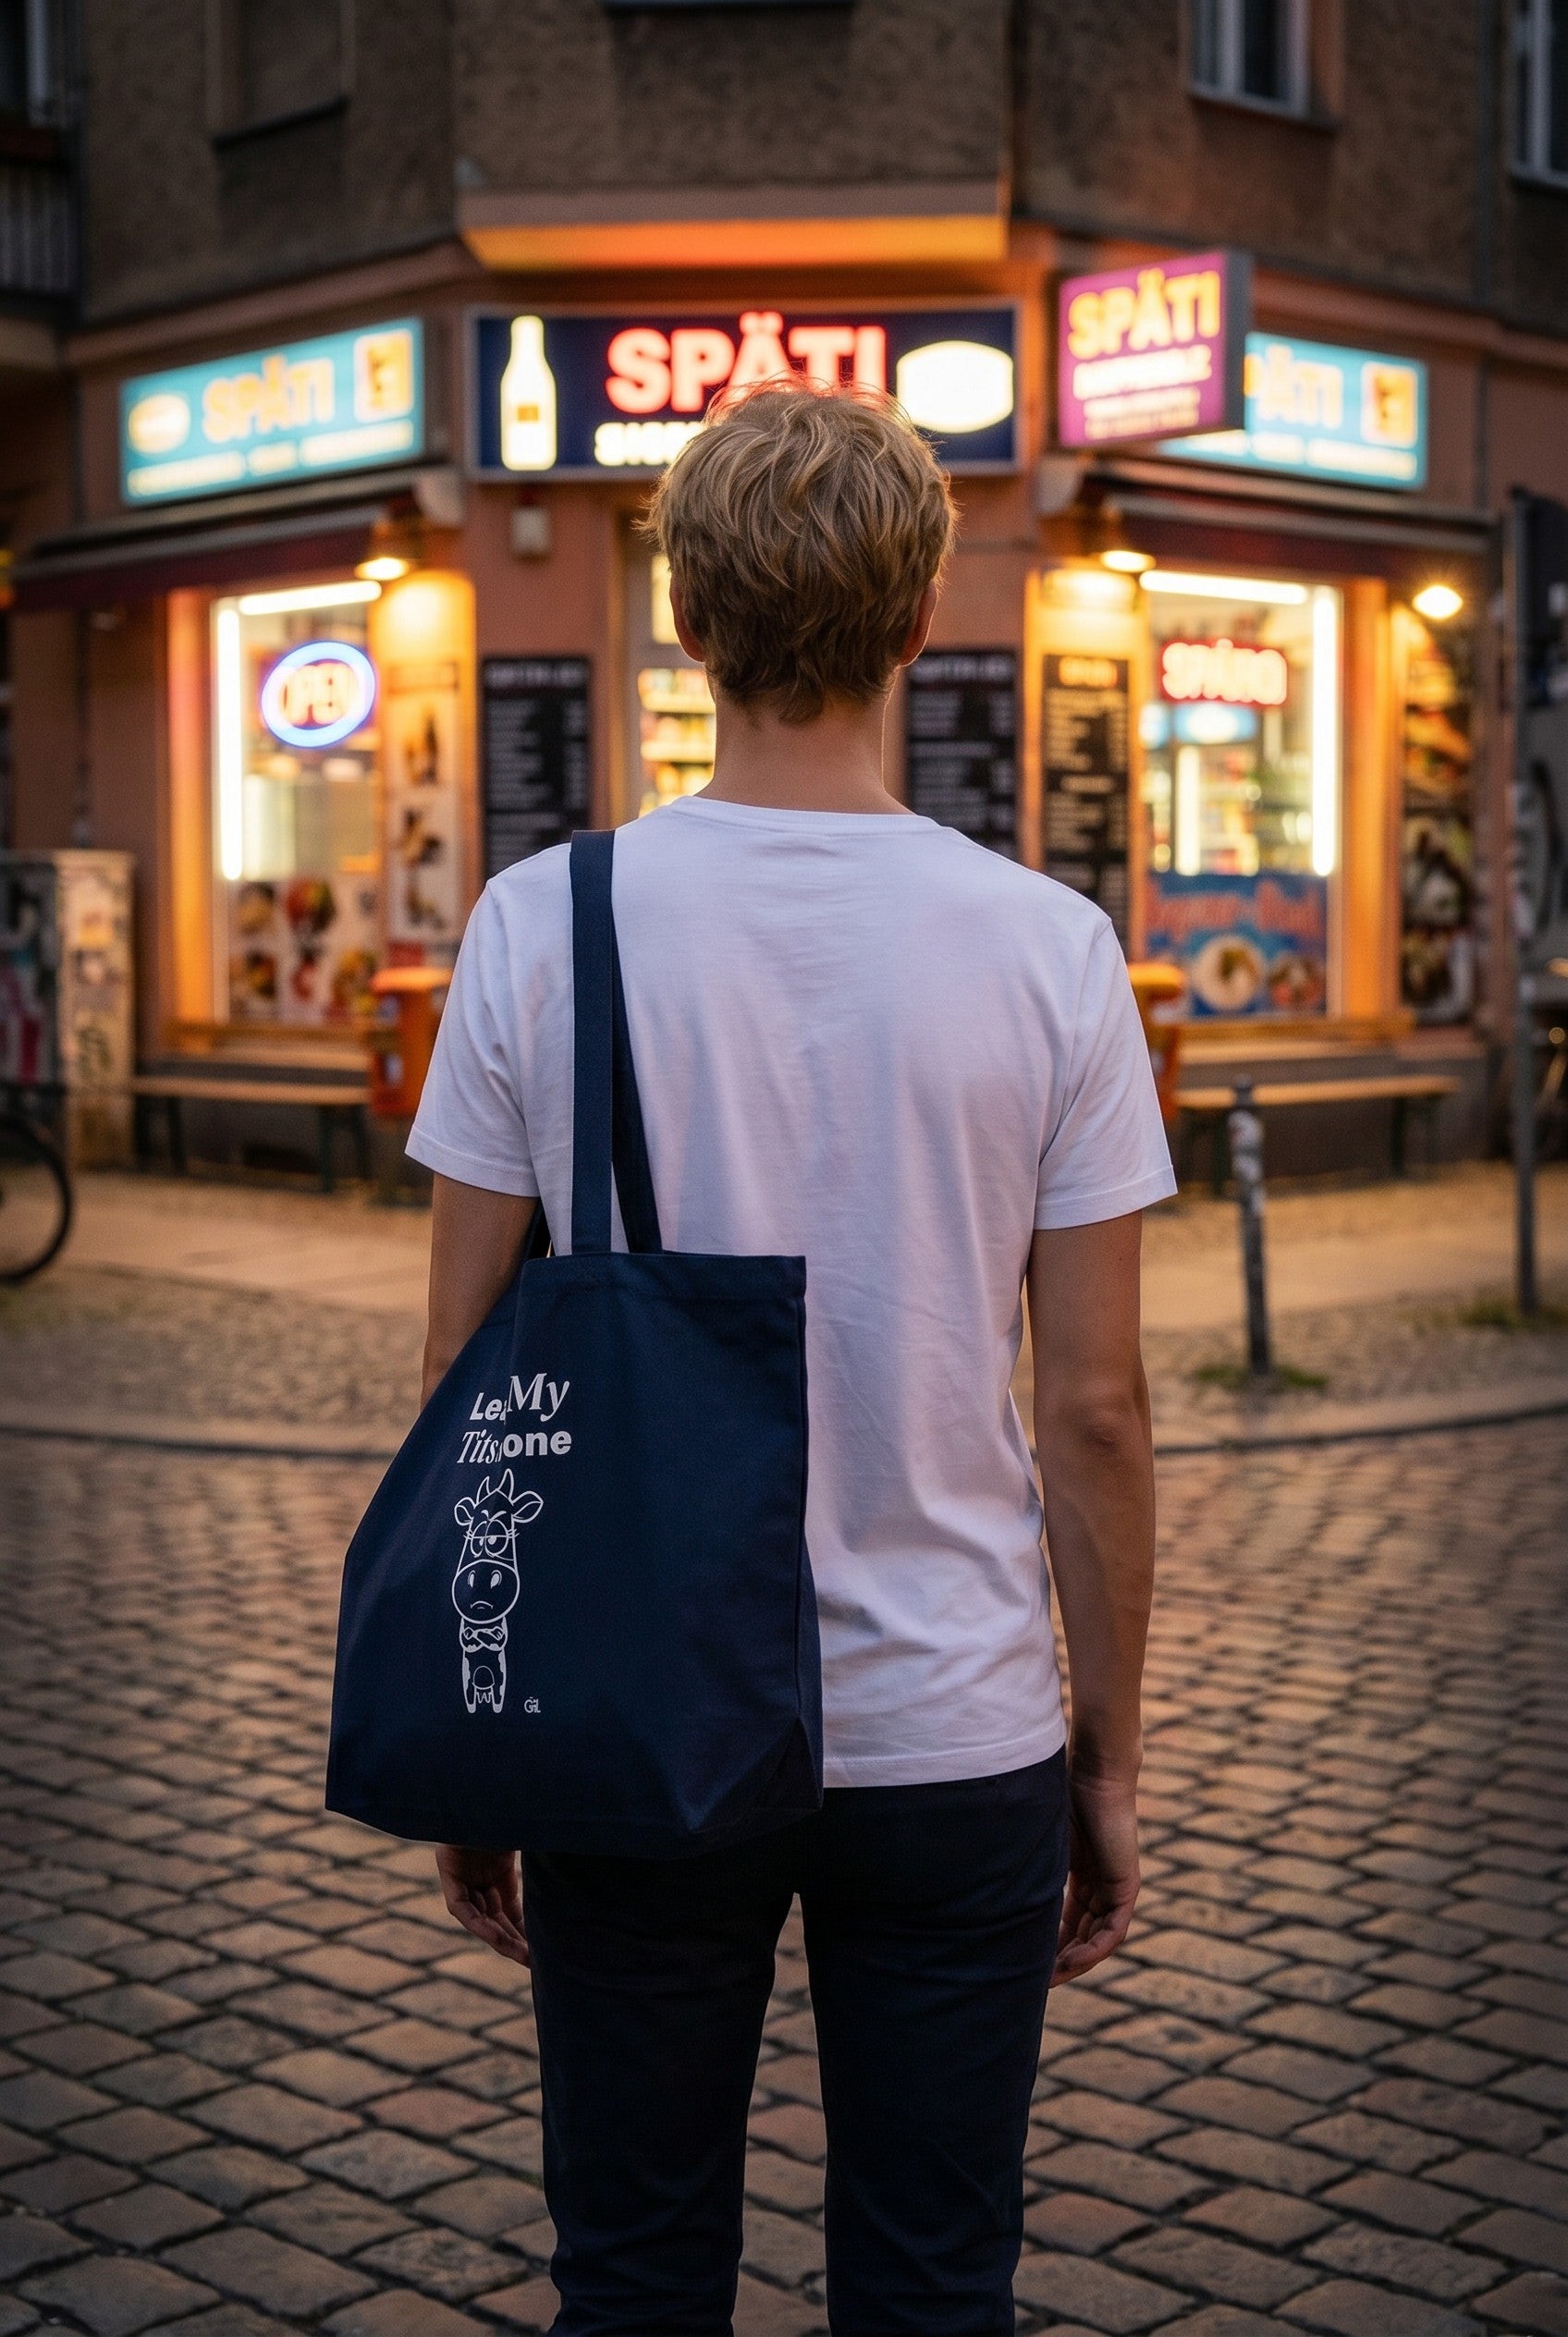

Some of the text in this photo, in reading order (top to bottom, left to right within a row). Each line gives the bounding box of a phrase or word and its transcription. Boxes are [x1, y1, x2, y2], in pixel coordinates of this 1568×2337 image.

[1068, 267, 1221, 360] SPÄTI
[202, 354, 336, 444] SPÄTI
[506, 1373, 570, 1422] My
[457, 1429, 572, 1464] Tits one
